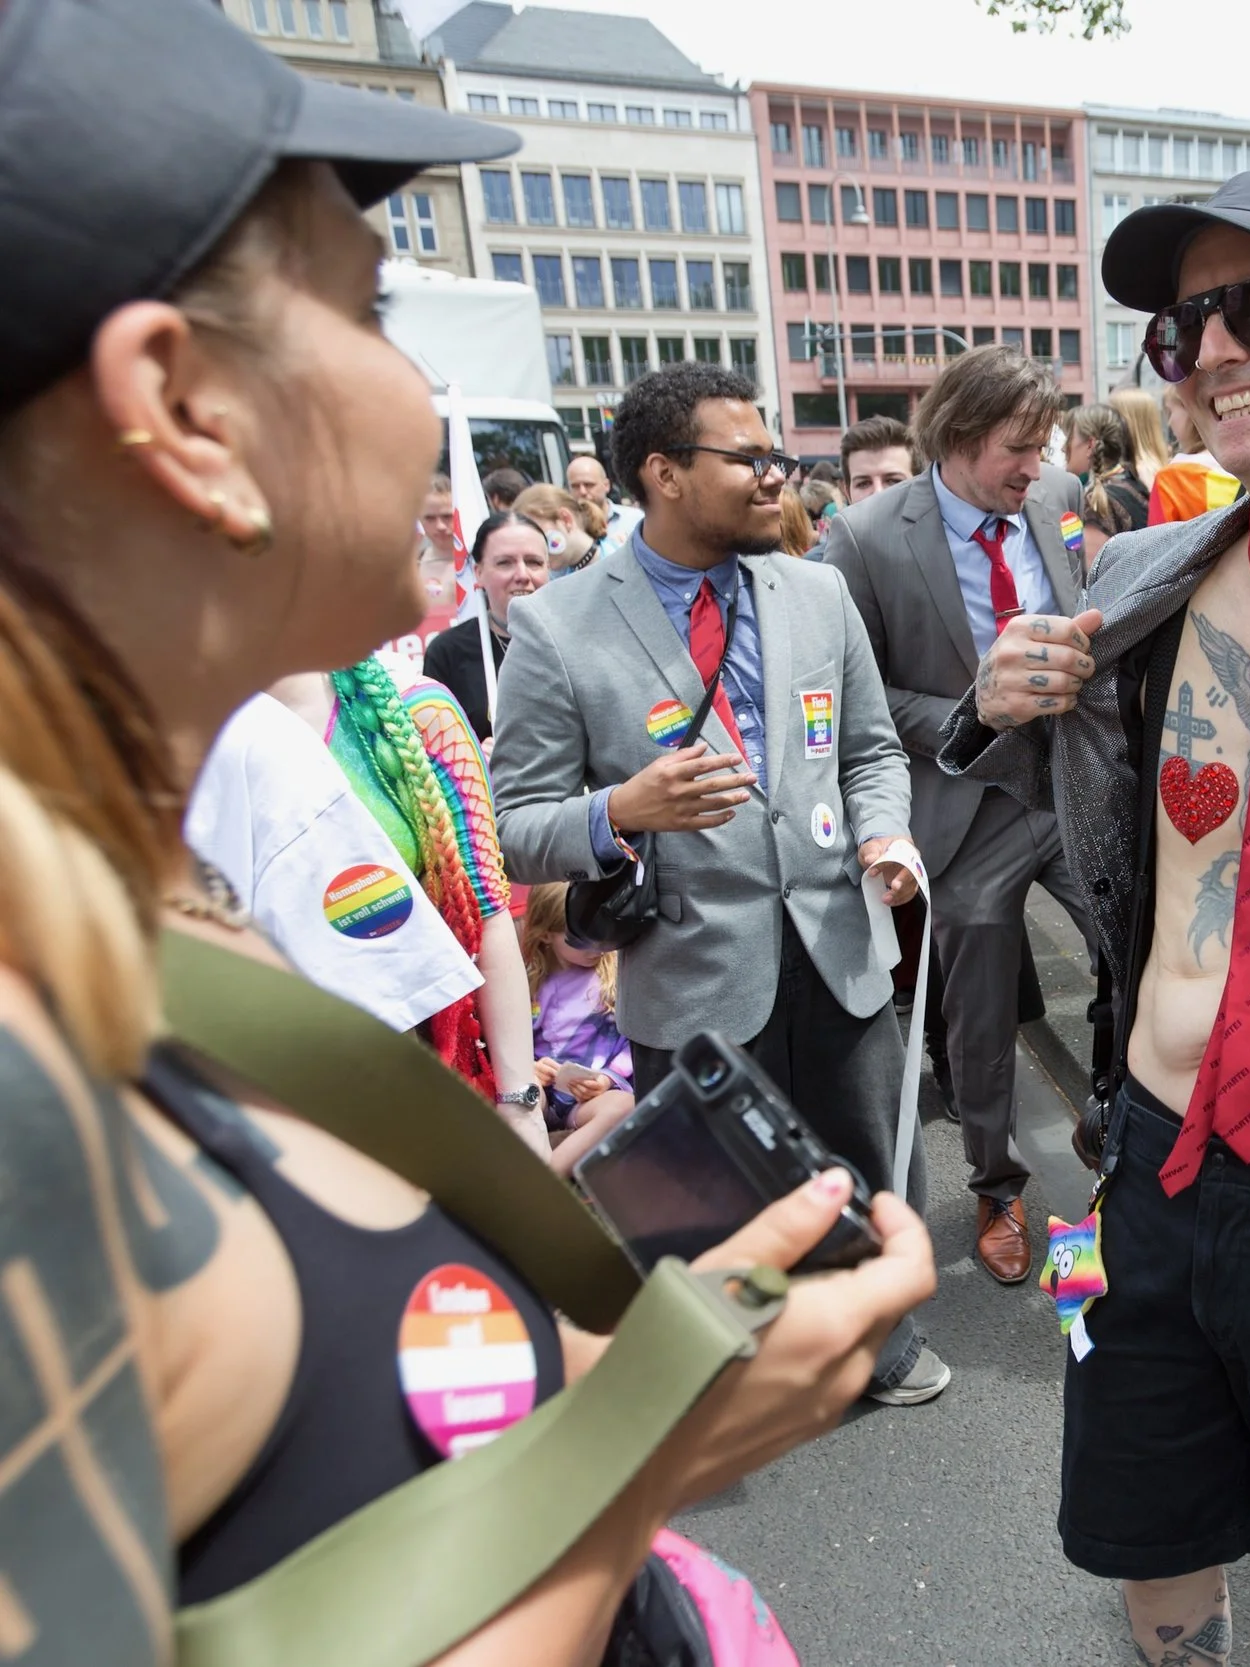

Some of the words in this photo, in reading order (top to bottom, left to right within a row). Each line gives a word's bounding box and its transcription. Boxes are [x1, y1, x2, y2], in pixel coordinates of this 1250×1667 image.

[327, 869, 387, 903] Homophobie
[336, 915, 353, 928] ist
[352, 906, 371, 921] voll
[371, 888, 407, 912] schwul!
